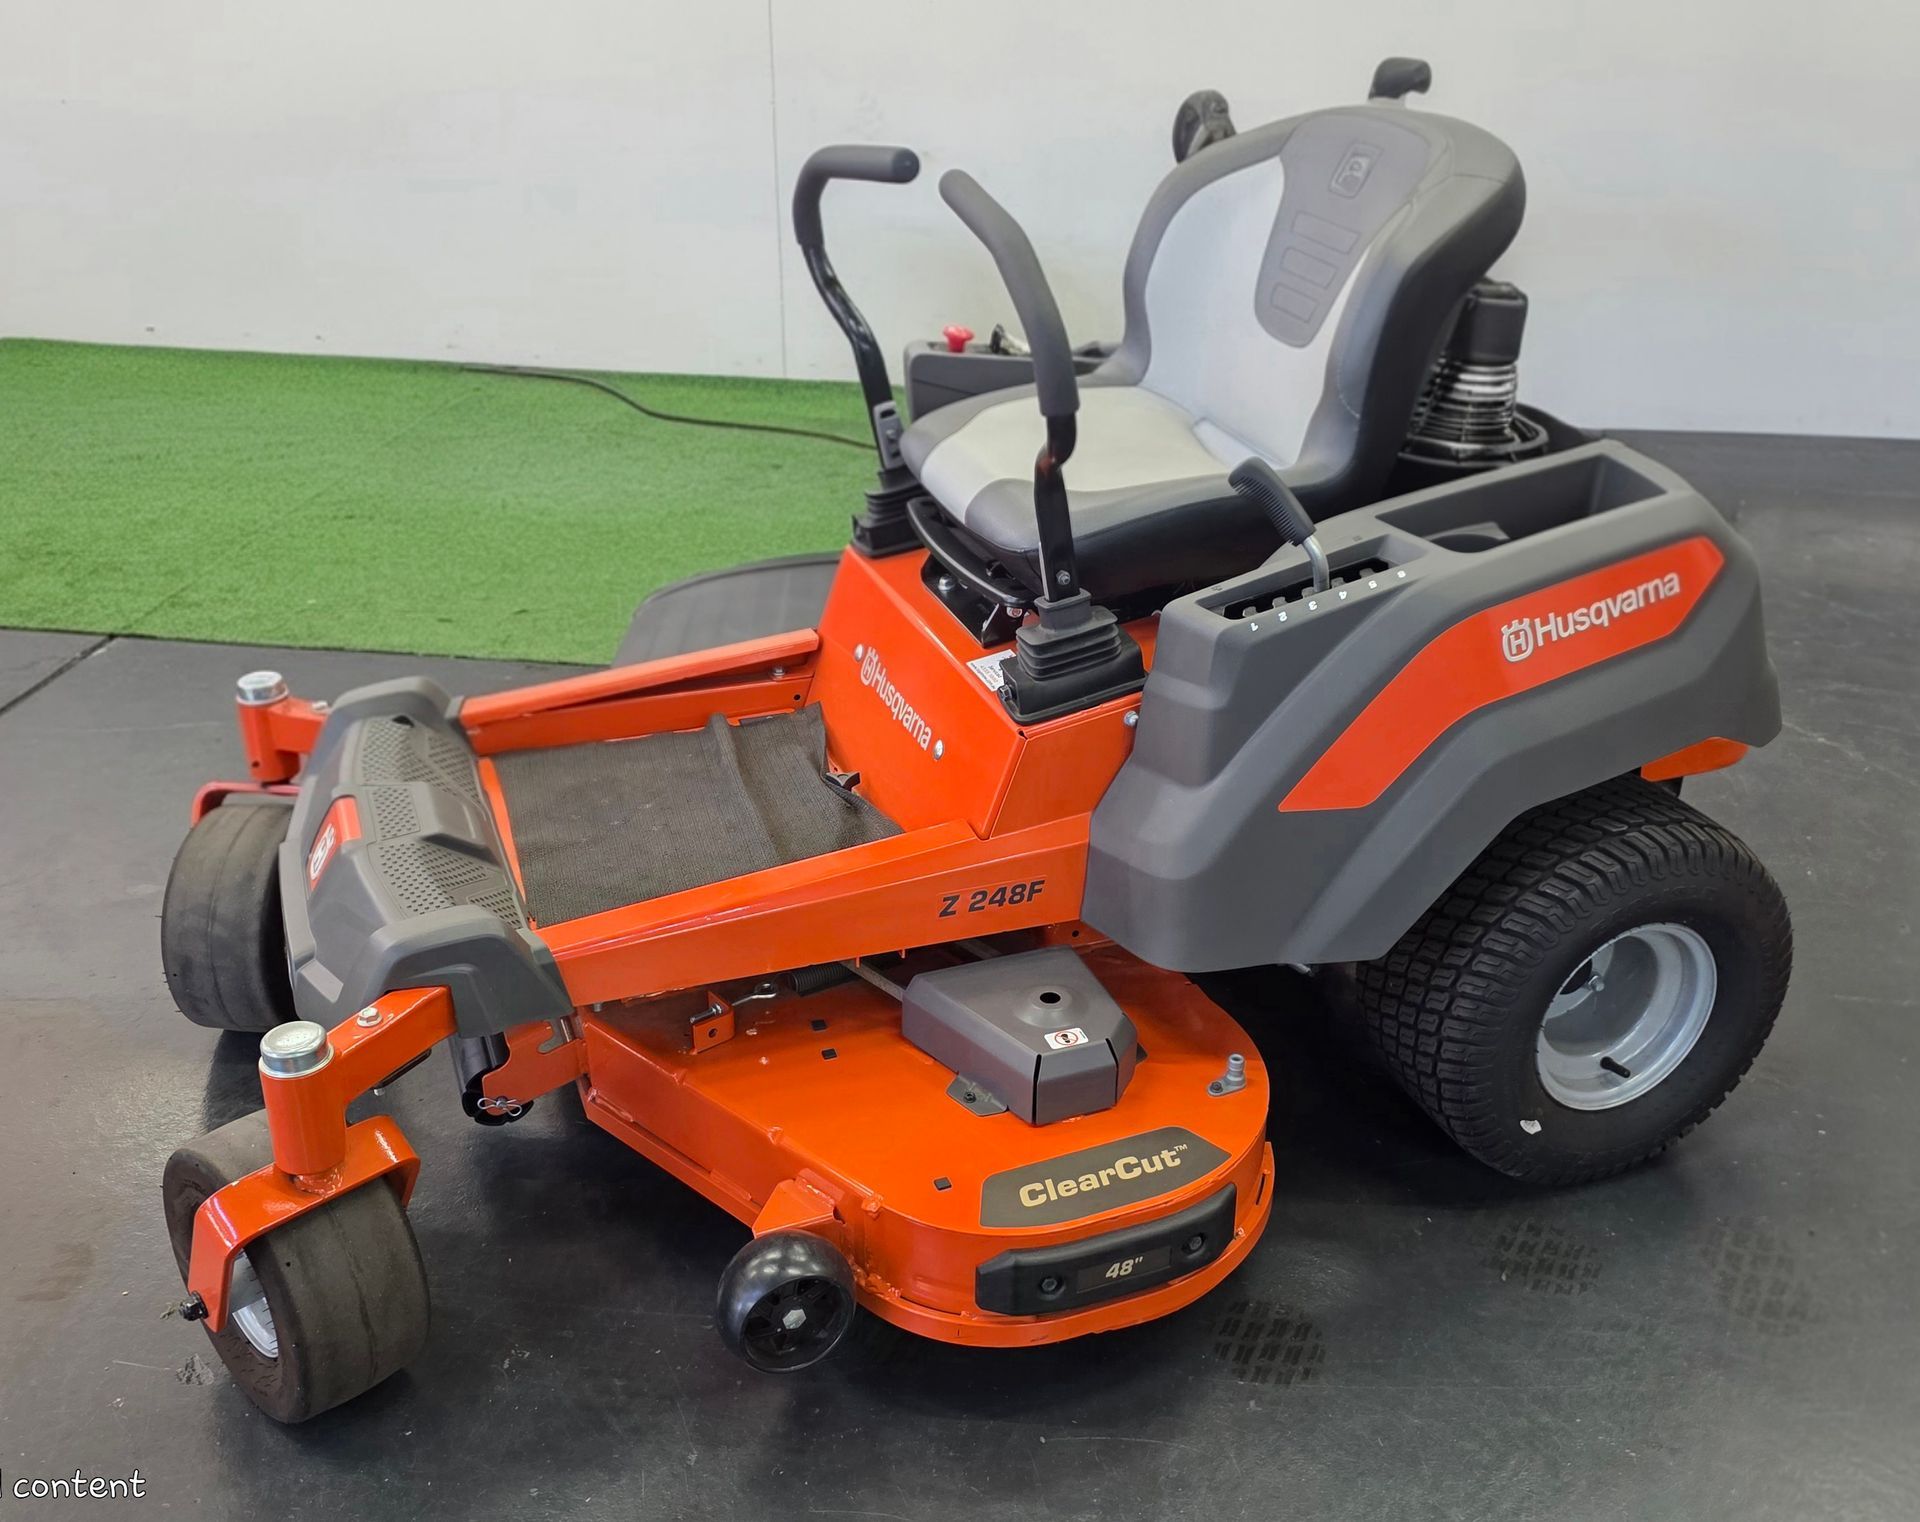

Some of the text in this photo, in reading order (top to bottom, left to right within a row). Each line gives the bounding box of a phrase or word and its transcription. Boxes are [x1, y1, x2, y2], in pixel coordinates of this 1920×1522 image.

[1250, 622, 1259, 632] 1
[1278, 611, 1288, 622] 2
[1308, 600, 1318, 611] 3
[1338, 590, 1348, 600] 4
[1368, 580, 1378, 589] 5
[1533, 572, 1681, 647] Husqvarna
[871, 662, 933, 750] Husqvarna
[938, 879, 1046, 918] Z 248F
